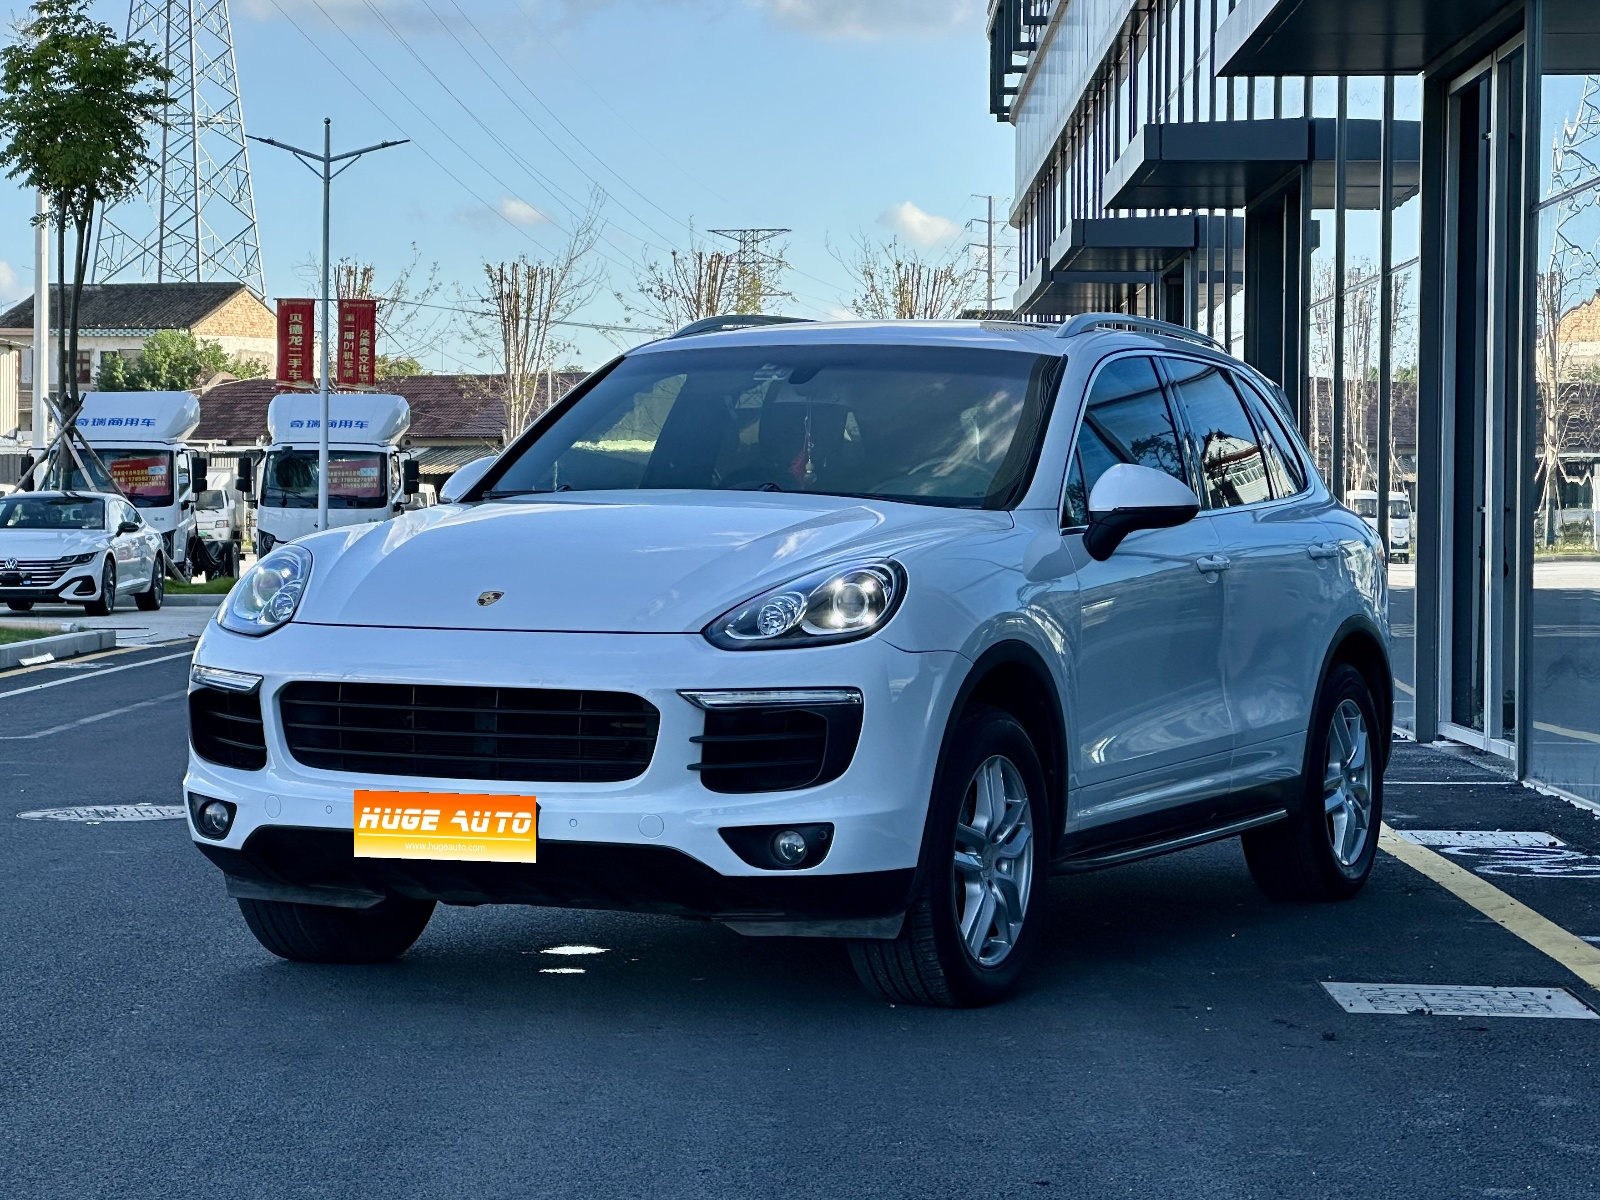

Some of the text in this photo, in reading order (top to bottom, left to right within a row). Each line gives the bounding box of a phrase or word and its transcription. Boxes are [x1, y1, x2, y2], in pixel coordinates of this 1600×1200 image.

[288, 314, 303, 380] 贝德龙二手车
